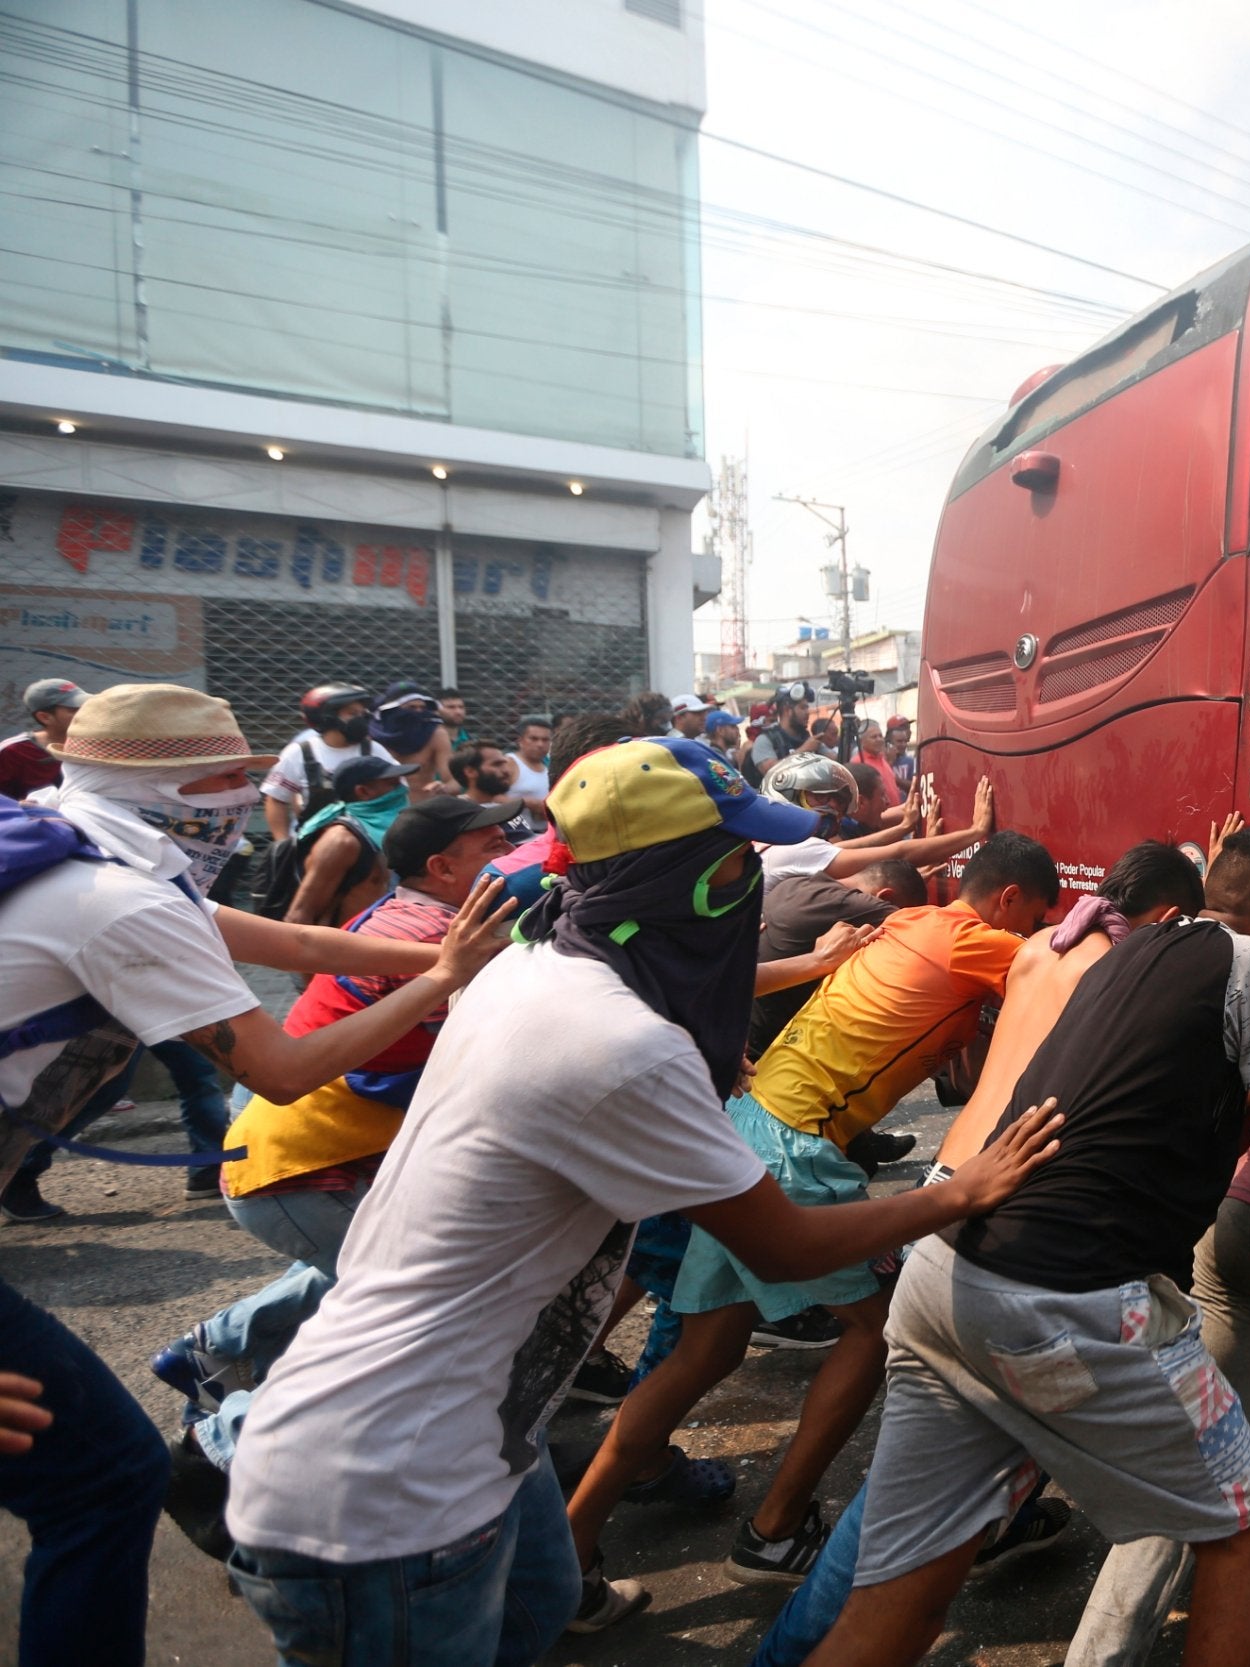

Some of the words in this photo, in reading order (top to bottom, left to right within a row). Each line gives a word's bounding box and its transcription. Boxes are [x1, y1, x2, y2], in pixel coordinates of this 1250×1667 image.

[1060, 862, 1078, 875] Poder
[1080, 863, 1105, 879] Popular
[1068, 877, 1099, 891] Terrestre
